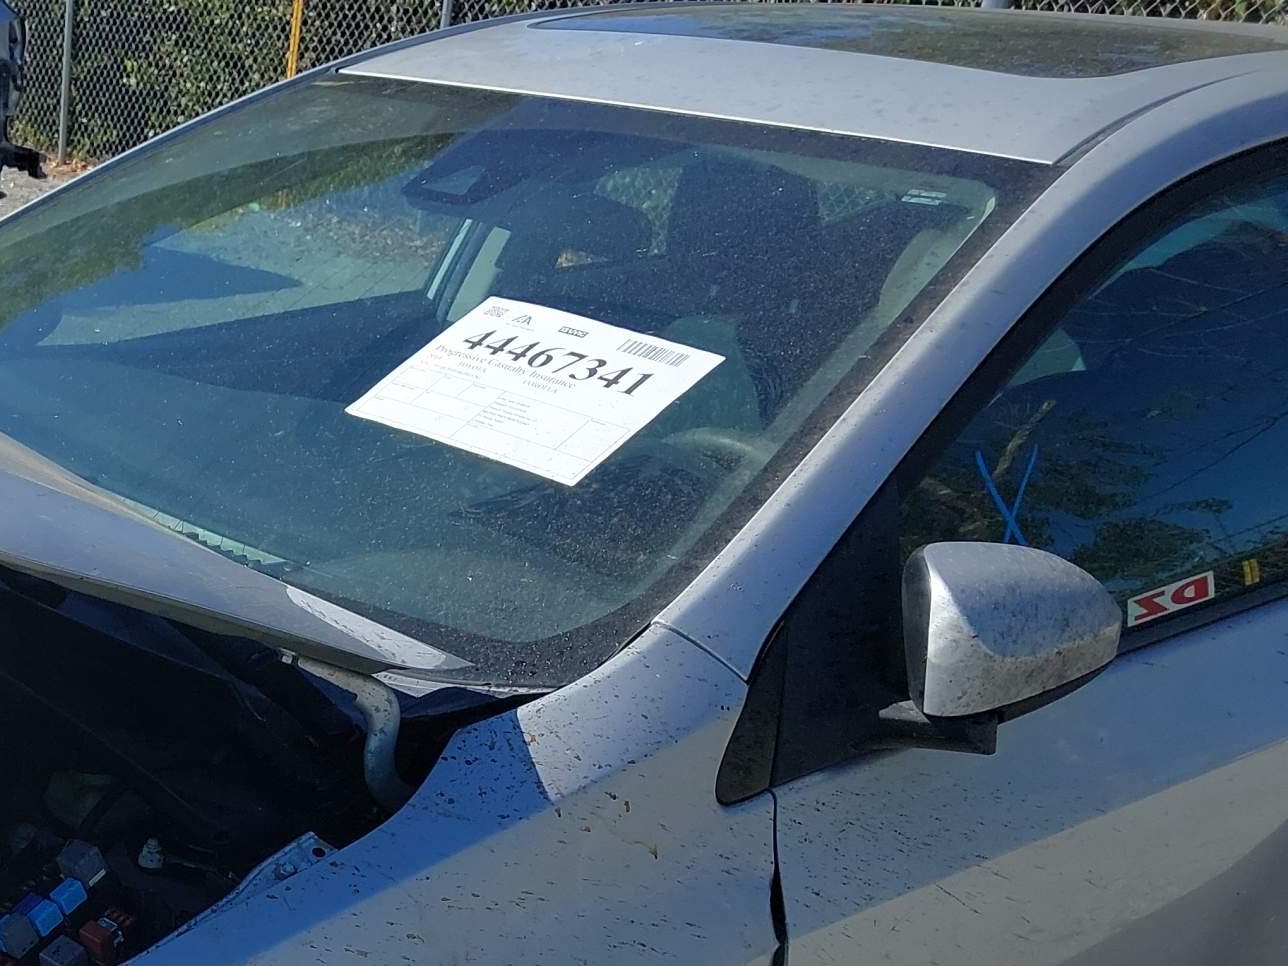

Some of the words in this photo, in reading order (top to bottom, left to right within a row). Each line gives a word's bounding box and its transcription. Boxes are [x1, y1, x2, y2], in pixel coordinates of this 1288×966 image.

[435, 343, 488, 365] Progressive
[486, 357, 528, 378] Casualty
[528, 368, 578, 390] Insurance
[463, 329, 657, 397] 44467341
